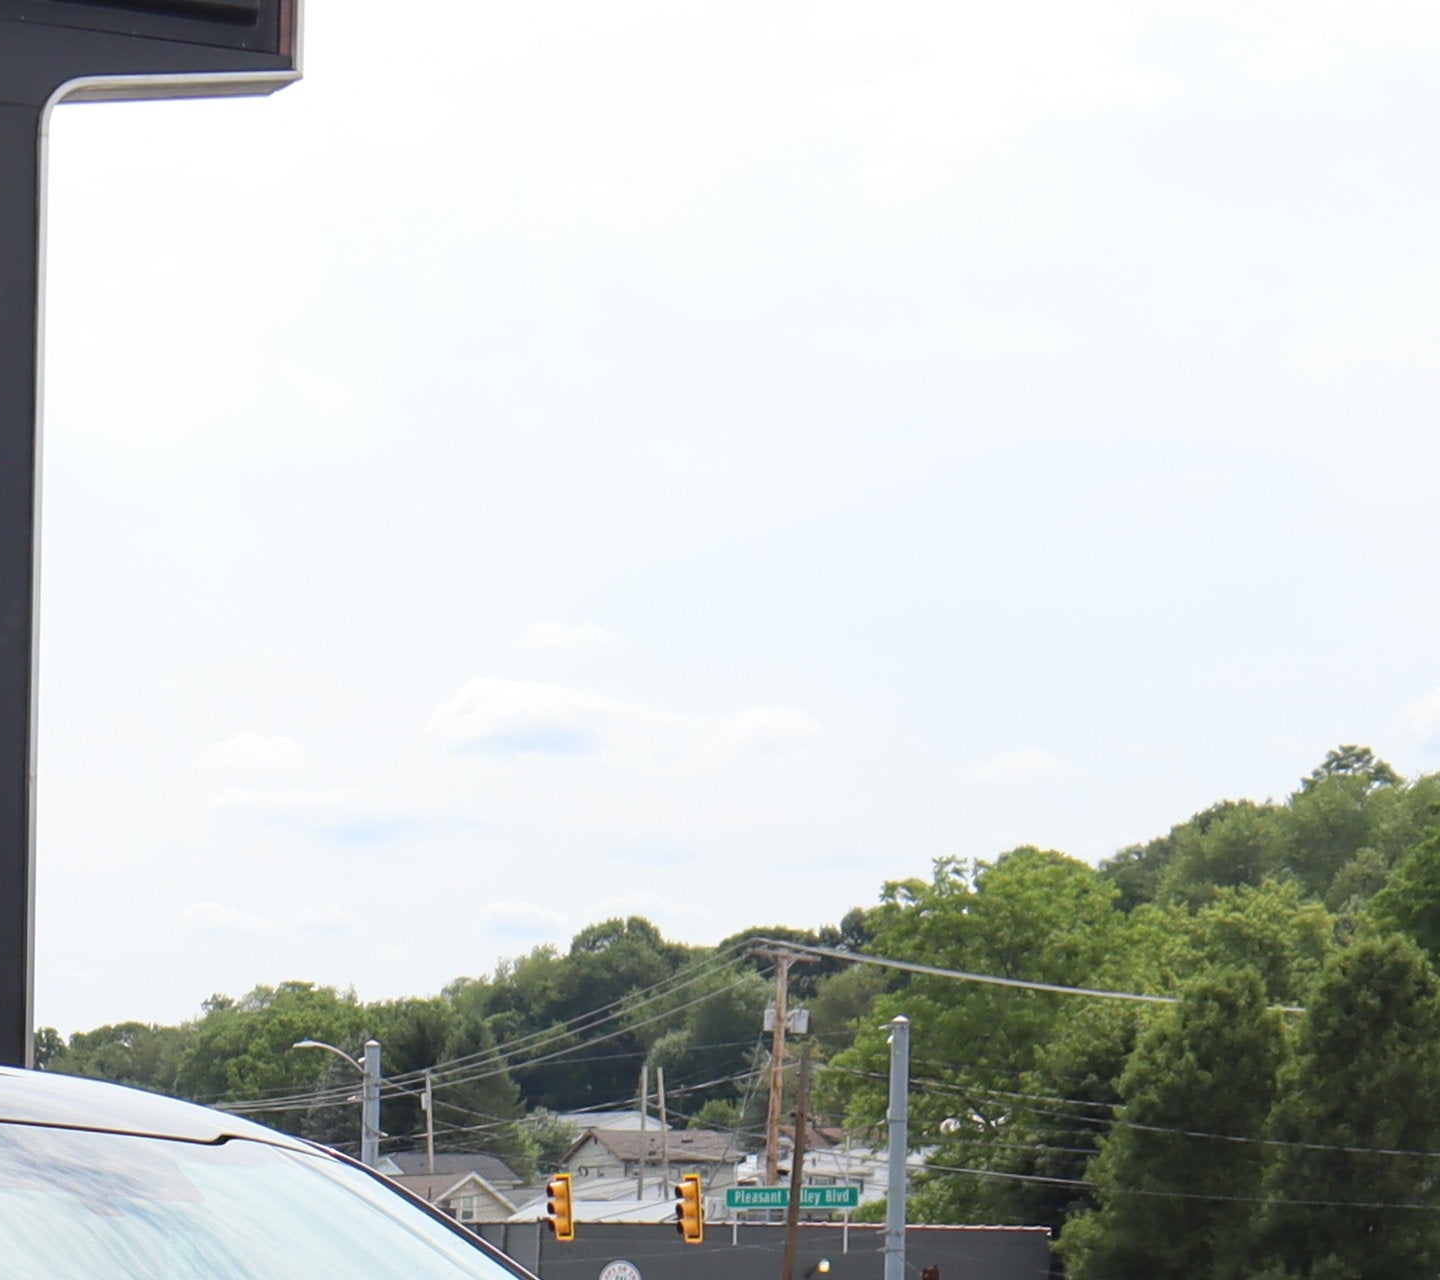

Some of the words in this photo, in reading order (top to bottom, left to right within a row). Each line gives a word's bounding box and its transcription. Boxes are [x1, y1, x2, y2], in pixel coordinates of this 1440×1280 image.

[734, 1190, 782, 1204] Pleasant
[787, 1190, 821, 1206] lley
[825, 1189, 850, 1203] Blvd
